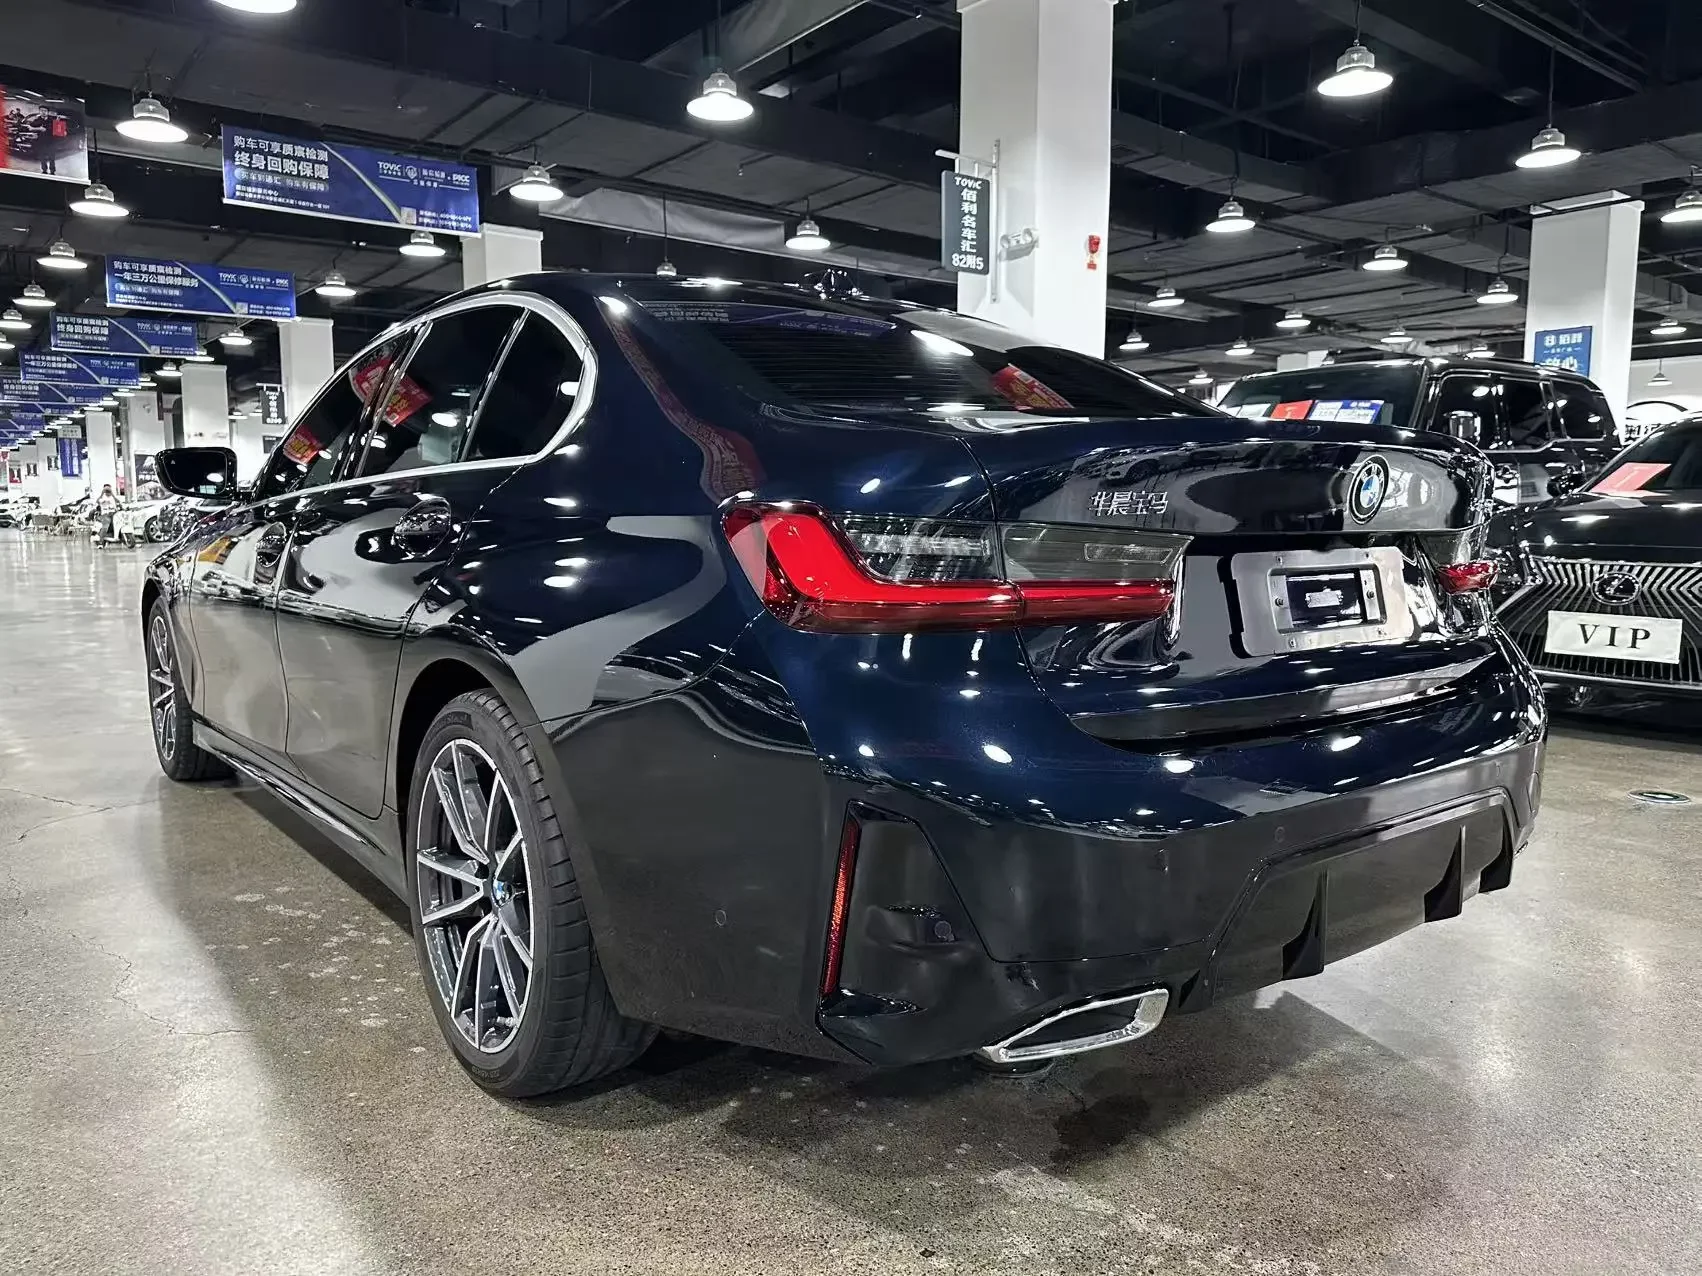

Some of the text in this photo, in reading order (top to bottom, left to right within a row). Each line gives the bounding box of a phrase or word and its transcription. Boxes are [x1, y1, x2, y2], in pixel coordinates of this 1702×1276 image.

[234, 150, 329, 180] 终身回购保障
[377, 161, 402, 172] TOVIC
[954, 176, 982, 190] TOVIC
[960, 187, 978, 253] 佰利名车汇
[1088, 490, 1169, 516] 华晨宝马
[1578, 623, 1651, 650] VIP
